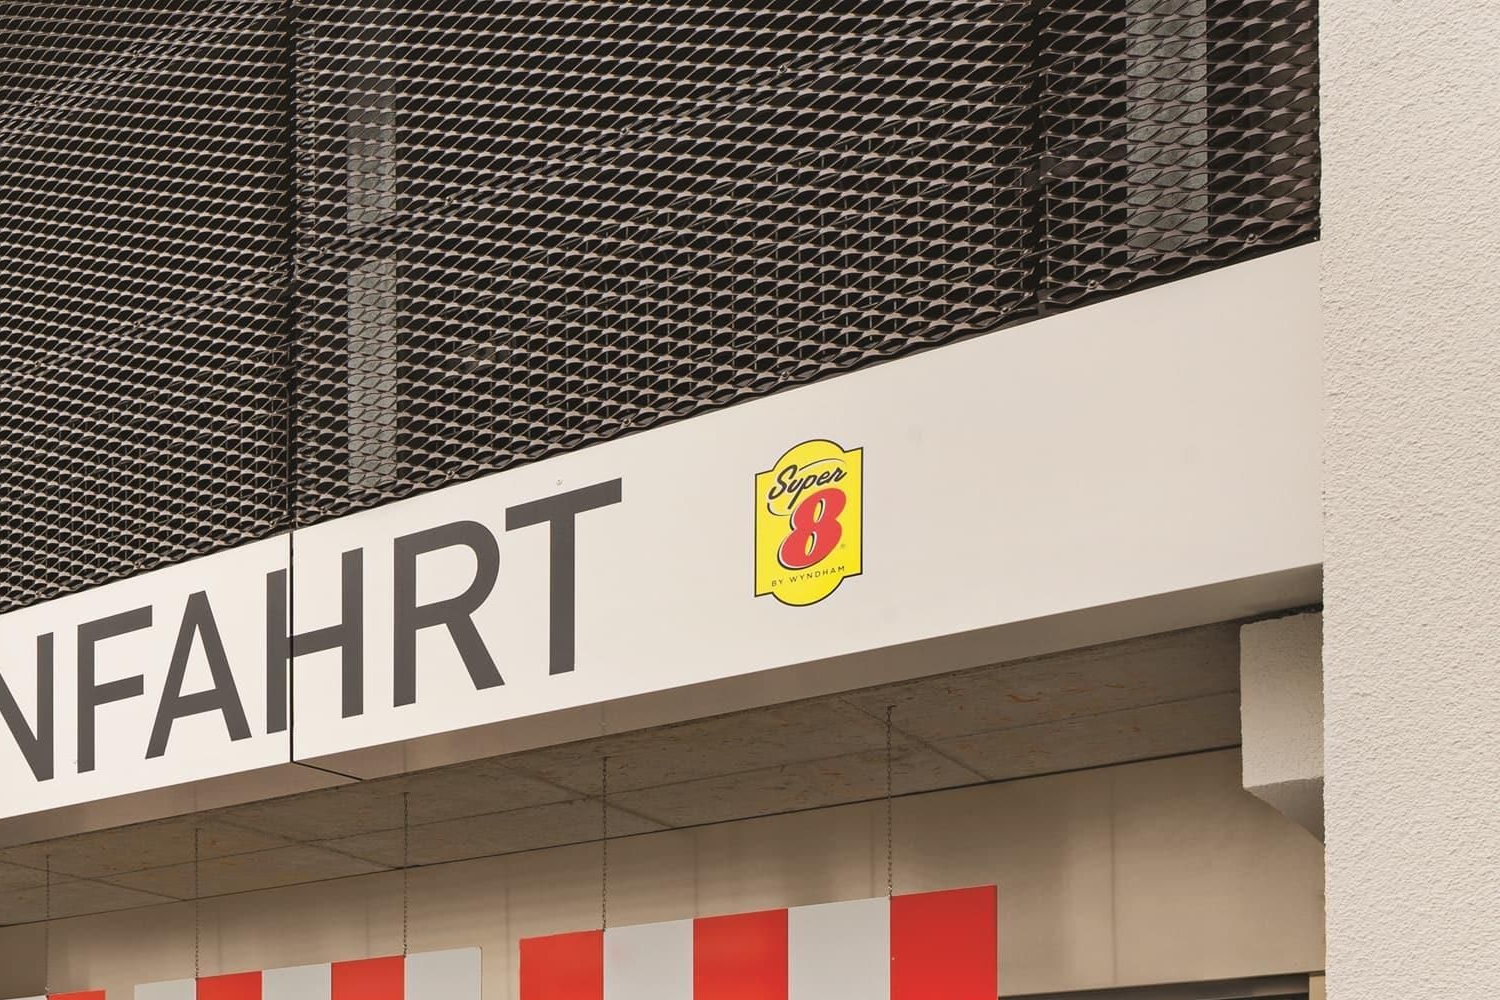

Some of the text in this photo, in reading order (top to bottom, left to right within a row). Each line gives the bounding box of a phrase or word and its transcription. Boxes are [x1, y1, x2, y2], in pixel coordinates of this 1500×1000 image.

[767, 463, 847, 509] Super
[777, 487, 847, 571] 8
[771, 565, 846, 587] BY WYNDHAM
